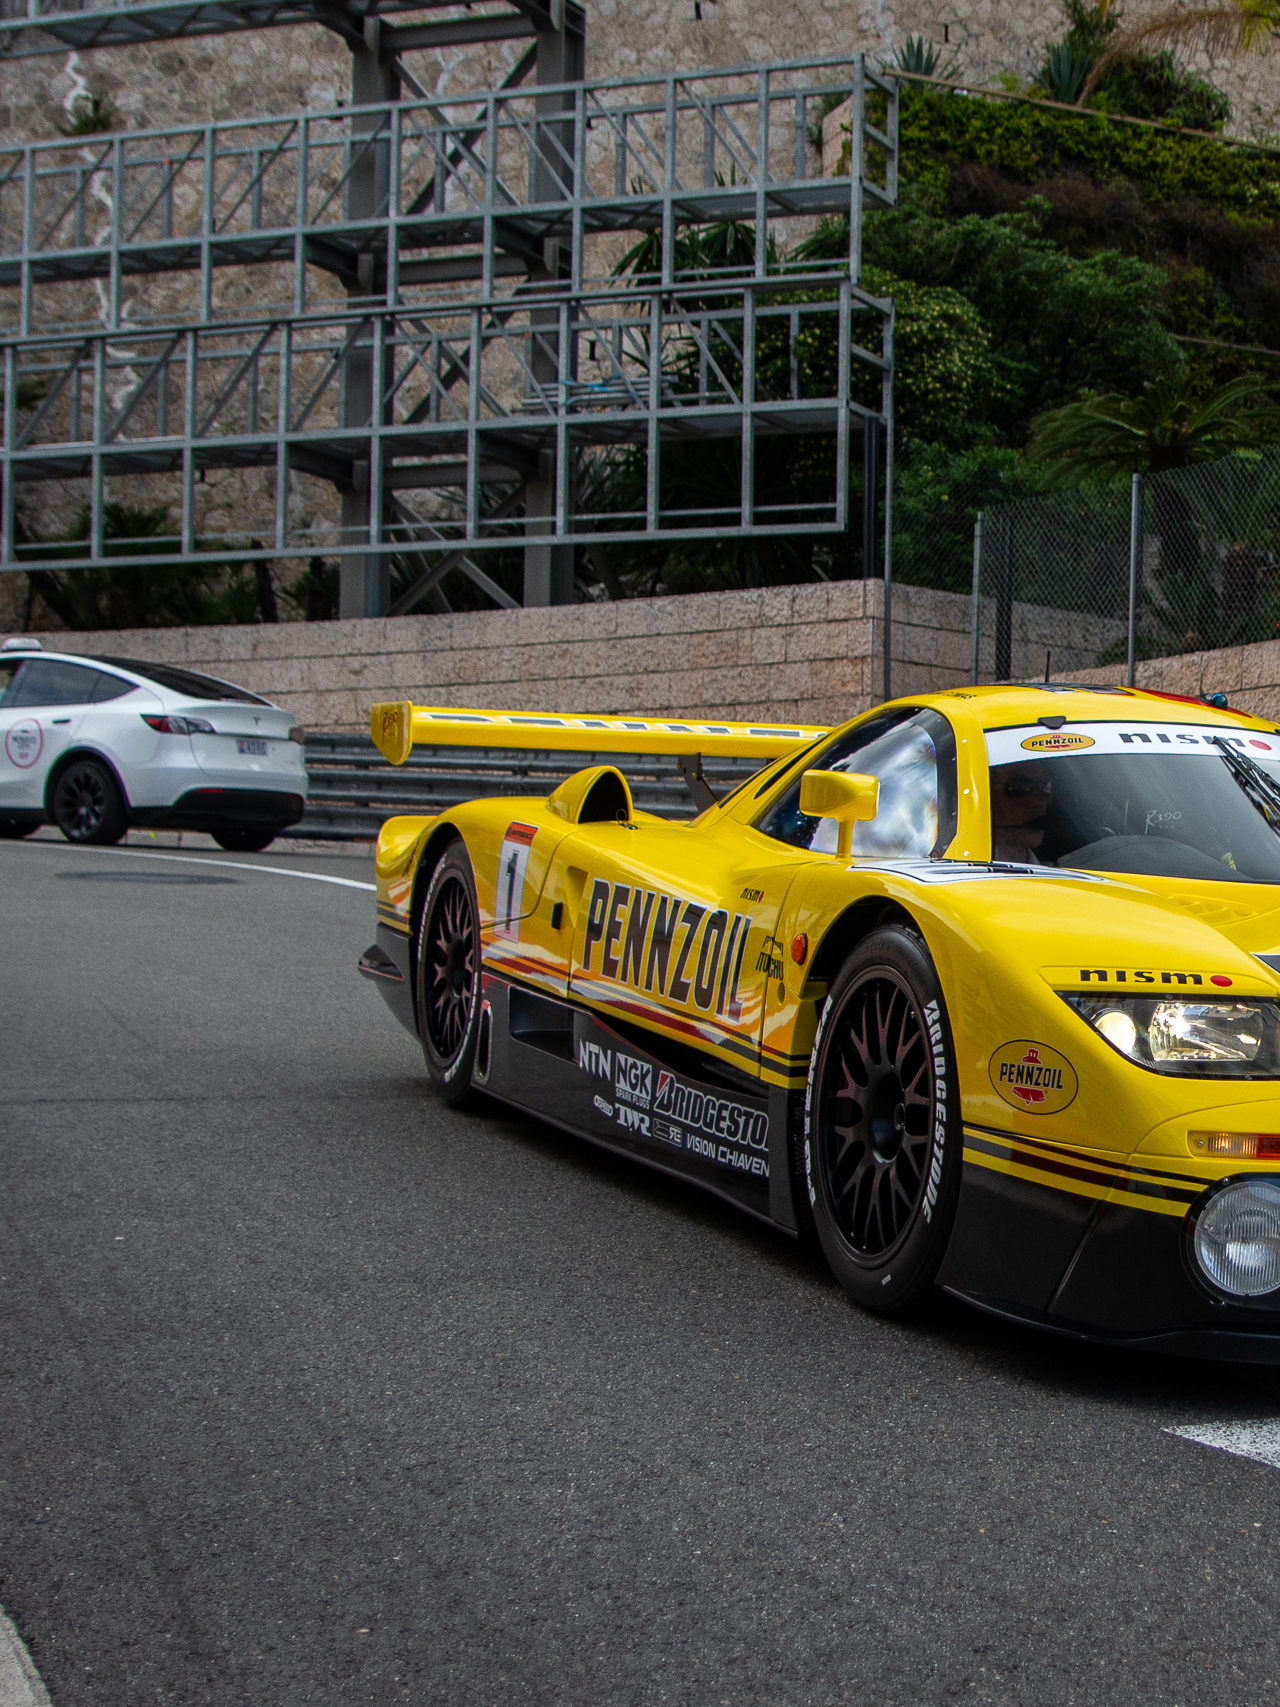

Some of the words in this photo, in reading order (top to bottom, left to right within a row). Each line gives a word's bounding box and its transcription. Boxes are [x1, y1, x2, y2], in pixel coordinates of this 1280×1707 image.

[1031, 737, 1084, 748] PENNZOIL
[505, 850, 519, 935] 1
[581, 877, 753, 1025] PENNZOIL
[579, 1038, 611, 1082] NTN
[616, 1053, 652, 1100] NGK
[999, 1061, 1064, 1090] PENNZOIL
[614, 1102, 652, 1137] TWR
[615, 1087, 632, 1104] SPARK
[633, 1093, 650, 1110] PLUGS
[653, 1069, 769, 1152] BRIDGESTO
[922, 999, 948, 1224] BRIDGESTONE
[686, 1133, 716, 1159] VISION
